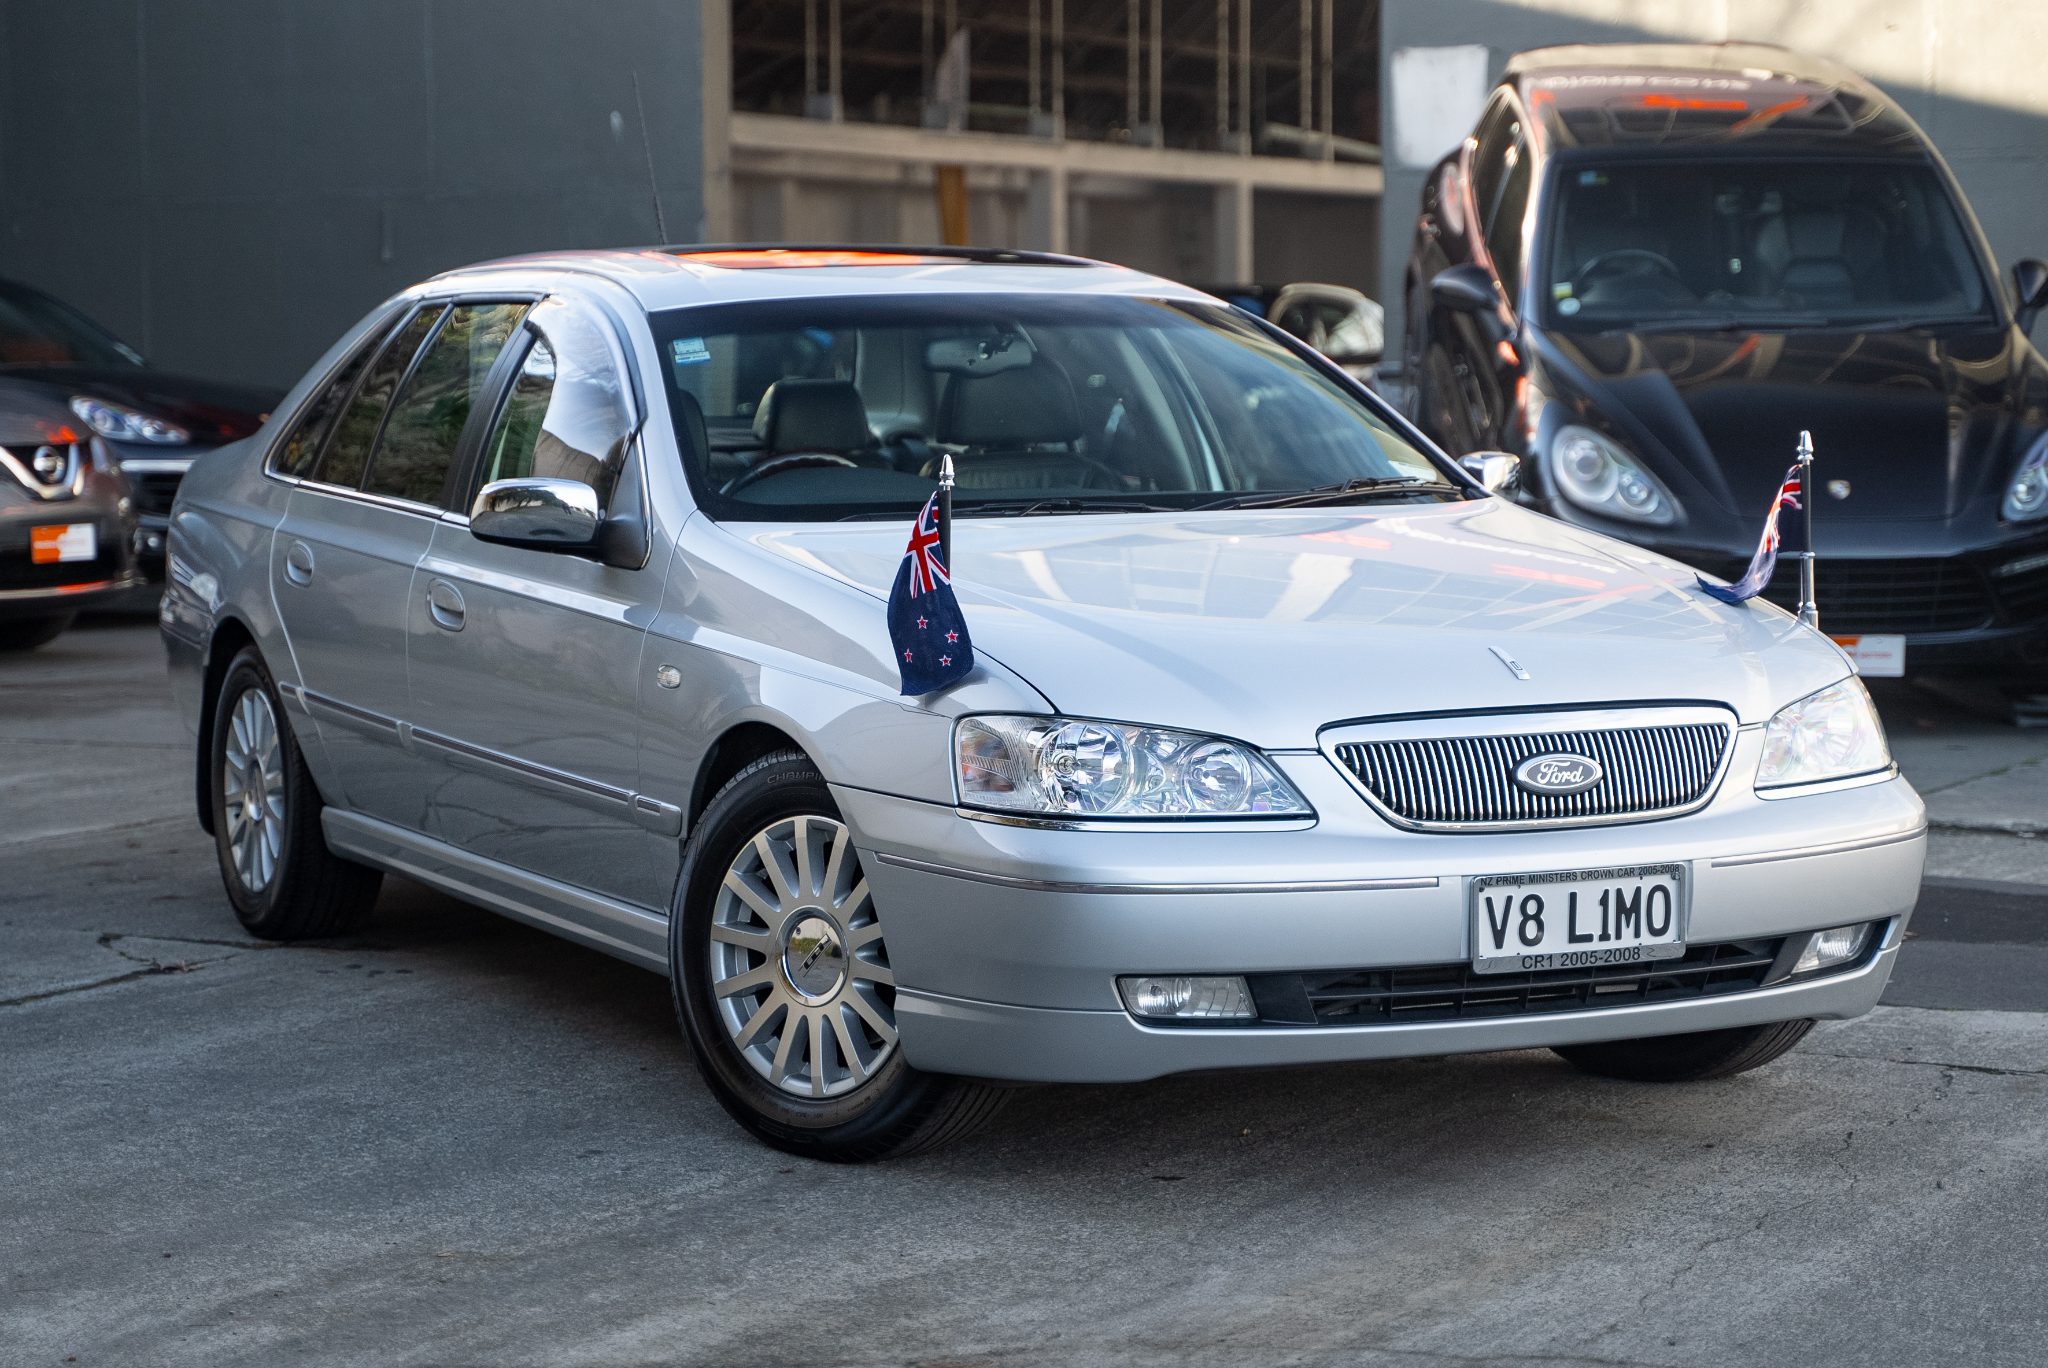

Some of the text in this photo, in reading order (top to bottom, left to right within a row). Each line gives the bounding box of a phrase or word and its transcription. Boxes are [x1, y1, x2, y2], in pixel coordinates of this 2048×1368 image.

[767, 771, 821, 784] CHAMPI
[1537, 761, 1584, 784] Ford
[1480, 863, 1680, 887] NZ PRIME MINISTERS CROWN CAR 2005-2008
[1485, 884, 1672, 950] V8 L1MO
[1521, 947, 1641, 970] CR1 2005-2008
